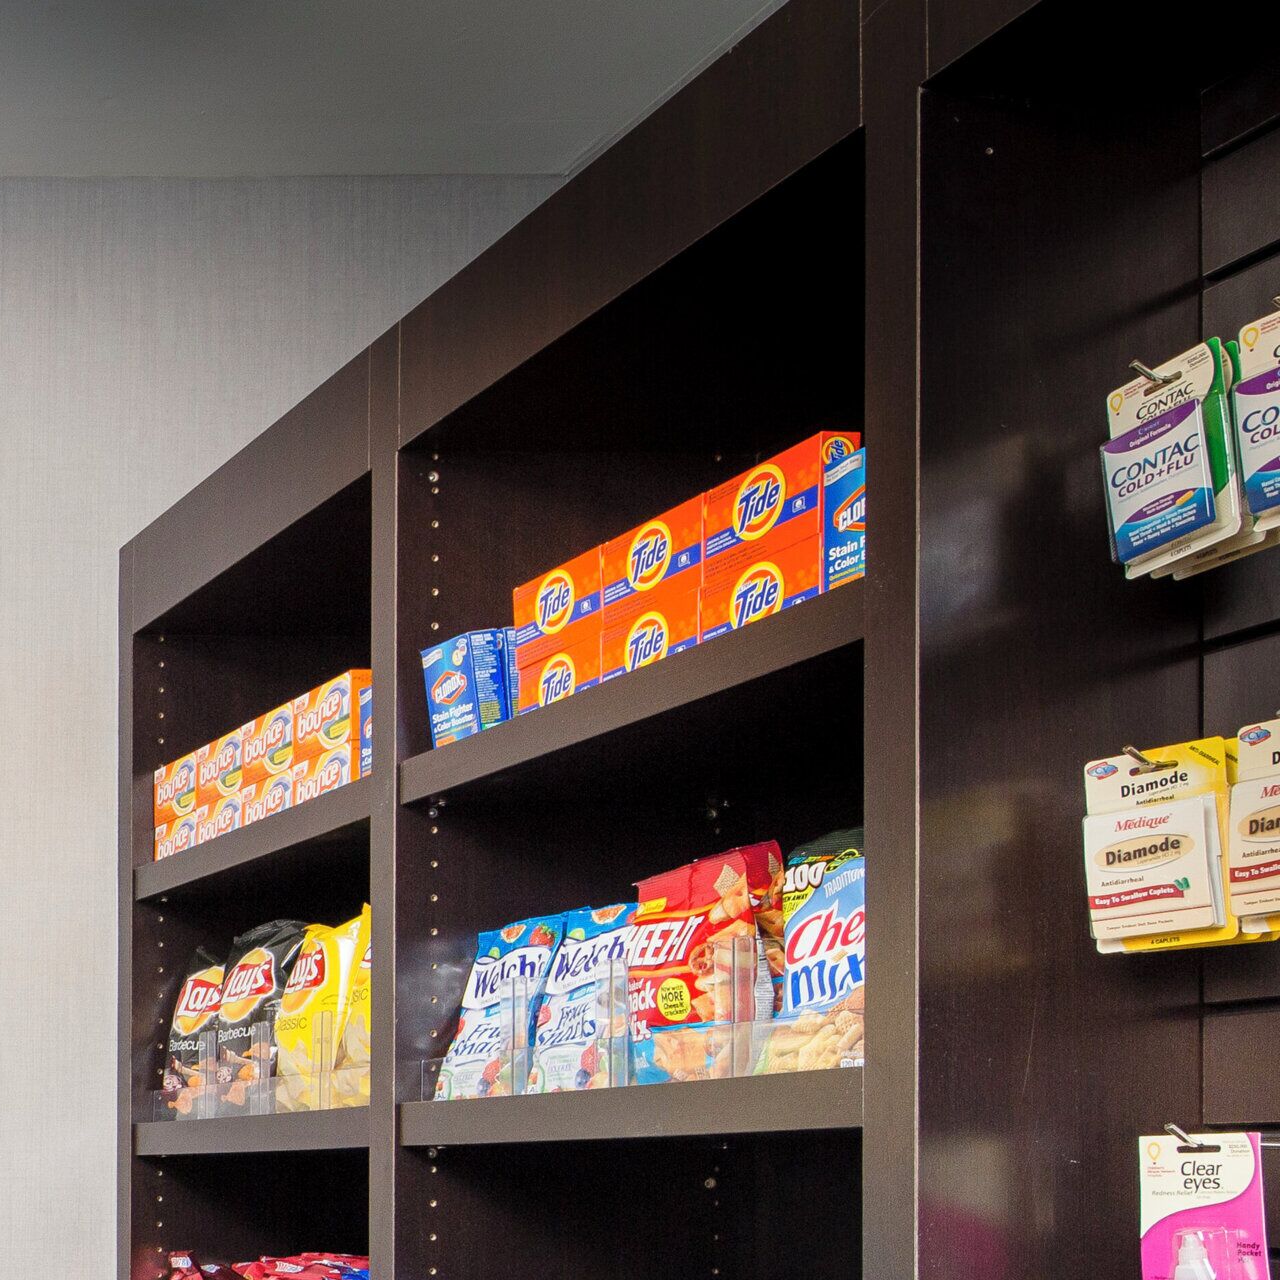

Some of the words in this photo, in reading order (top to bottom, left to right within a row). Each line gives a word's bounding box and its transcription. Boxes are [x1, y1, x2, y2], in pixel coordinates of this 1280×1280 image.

[1136, 382, 1194, 420] CONTAC
[1111, 433, 1199, 488] CONTAC
[1118, 453, 1194, 497] COLD+FLU
[735, 478, 780, 536] Tide
[628, 535, 667, 589] Tide
[829, 540, 857, 561] Stain
[835, 554, 859, 570] Color
[537, 582, 570, 631] Tide
[733, 575, 778, 628] Tide
[625, 624, 664, 671] Tide
[435, 671, 462, 704] CLOROX
[542, 663, 572, 706] Tide
[297, 692, 341, 737] bounce
[244, 720, 283, 763] bounce
[199, 747, 234, 785] bounce
[296, 760, 340, 805] bounce
[1121, 770, 1188, 798] Diamode
[157, 768, 189, 805] bounce
[244, 786, 283, 825] bounce
[157, 826, 189, 861] bounce
[198, 807, 233, 844] bounce
[1105, 837, 1181, 866] Diamode
[784, 861, 828, 893] 100
[1101, 875, 1144, 888] Antidiarrheal
[1095, 895, 1110, 906] Easy
[1111, 893, 1120, 902] To
[1121, 890, 1148, 901] Swallow
[1149, 886, 1174, 898] Caplets
[221, 962, 270, 1005] Lay's
[661, 989, 684, 1002] MORE
[169, 1039, 207, 1053] Barbecue
[218, 1025, 256, 1043] Barbecue
[538, 1014, 596, 1047] Snacks
[1180, 1160, 1222, 1177] Clear
[1236, 1242, 1260, 1252] Handy
[1237, 1248, 1262, 1258] Pocket
